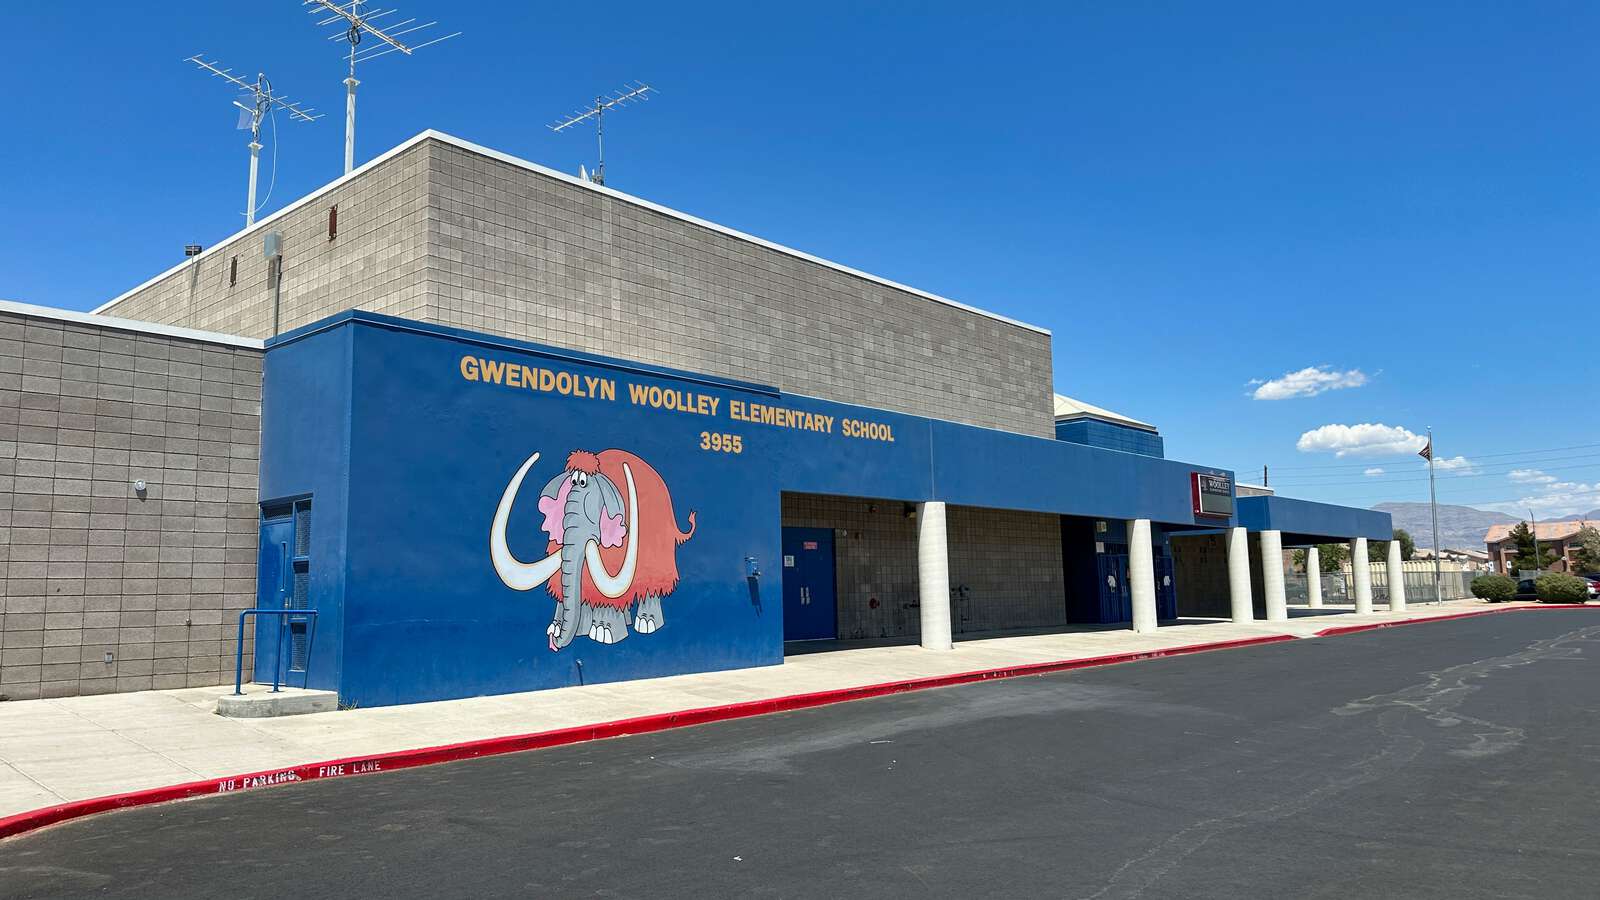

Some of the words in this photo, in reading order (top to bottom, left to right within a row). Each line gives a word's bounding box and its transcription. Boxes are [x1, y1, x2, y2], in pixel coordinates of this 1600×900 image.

[460, 355, 616, 401] GWENDOLYN
[629, 383, 720, 417] WOOLLEY
[729, 399, 834, 434] ELEMENTARY
[842, 418, 895, 442] SCHOOL
[700, 431, 743, 454] 3955
[219, 779, 235, 793] NO
[243, 770, 295, 788] PARKING
[319, 764, 345, 777] FIRE
[353, 761, 382, 773] LANE
